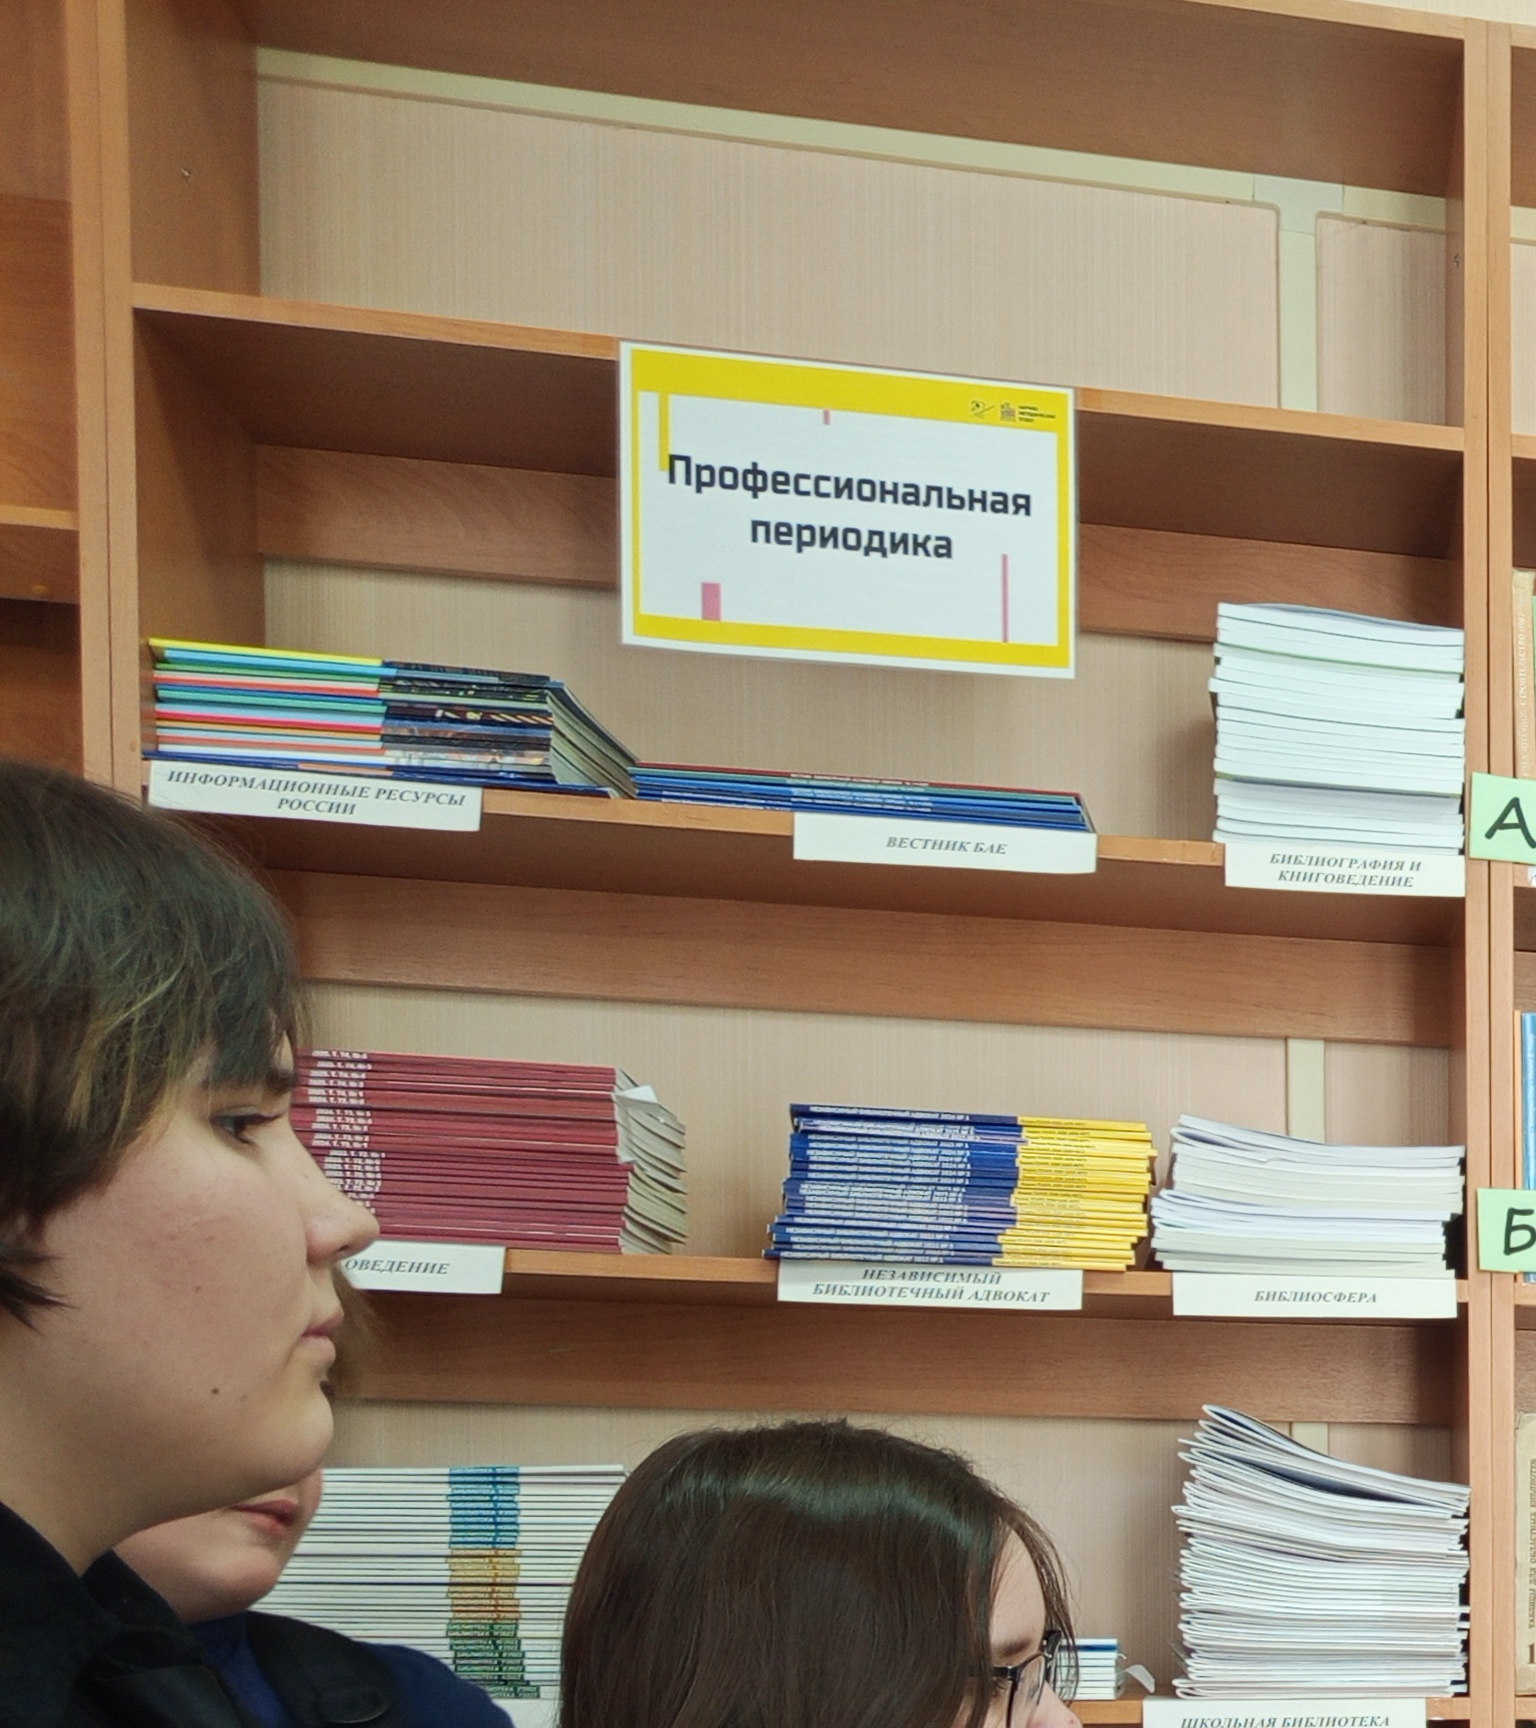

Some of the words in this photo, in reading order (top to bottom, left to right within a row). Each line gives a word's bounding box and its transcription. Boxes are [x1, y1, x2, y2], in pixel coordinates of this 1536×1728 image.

[668, 454, 1032, 516] Профессиональная
[750, 519, 953, 559] периодика
[167, 768, 372, 802] ИНФОРМАЦИОННЫЕ
[375, 787, 466, 809] РЕСУРСЫ
[277, 795, 356, 818] РОССИИ
[885, 835, 970, 855] ВЕСТНИК
[972, 839, 1008, 858] БАЕ
[1270, 853, 1405, 871] БИБЛИОГРАФИЯ
[1409, 861, 1422, 872] И
[1278, 870, 1414, 887] КНИГОВЕДЕНИЕ
[345, 1259, 450, 1274] ОВЕДЕНИЕ
[862, 1269, 1002, 1284] НЕЗАВИСИМЫЙ
[812, 1283, 965, 1300] БИБЛИОТЕЧНЫЙ
[968, 1289, 1050, 1303] АДВОКАТ
[1253, 1288, 1379, 1307] БИБЛИОСФЕРА
[1281, 1715, 1391, 1728] БИБЛИОТЕКА
